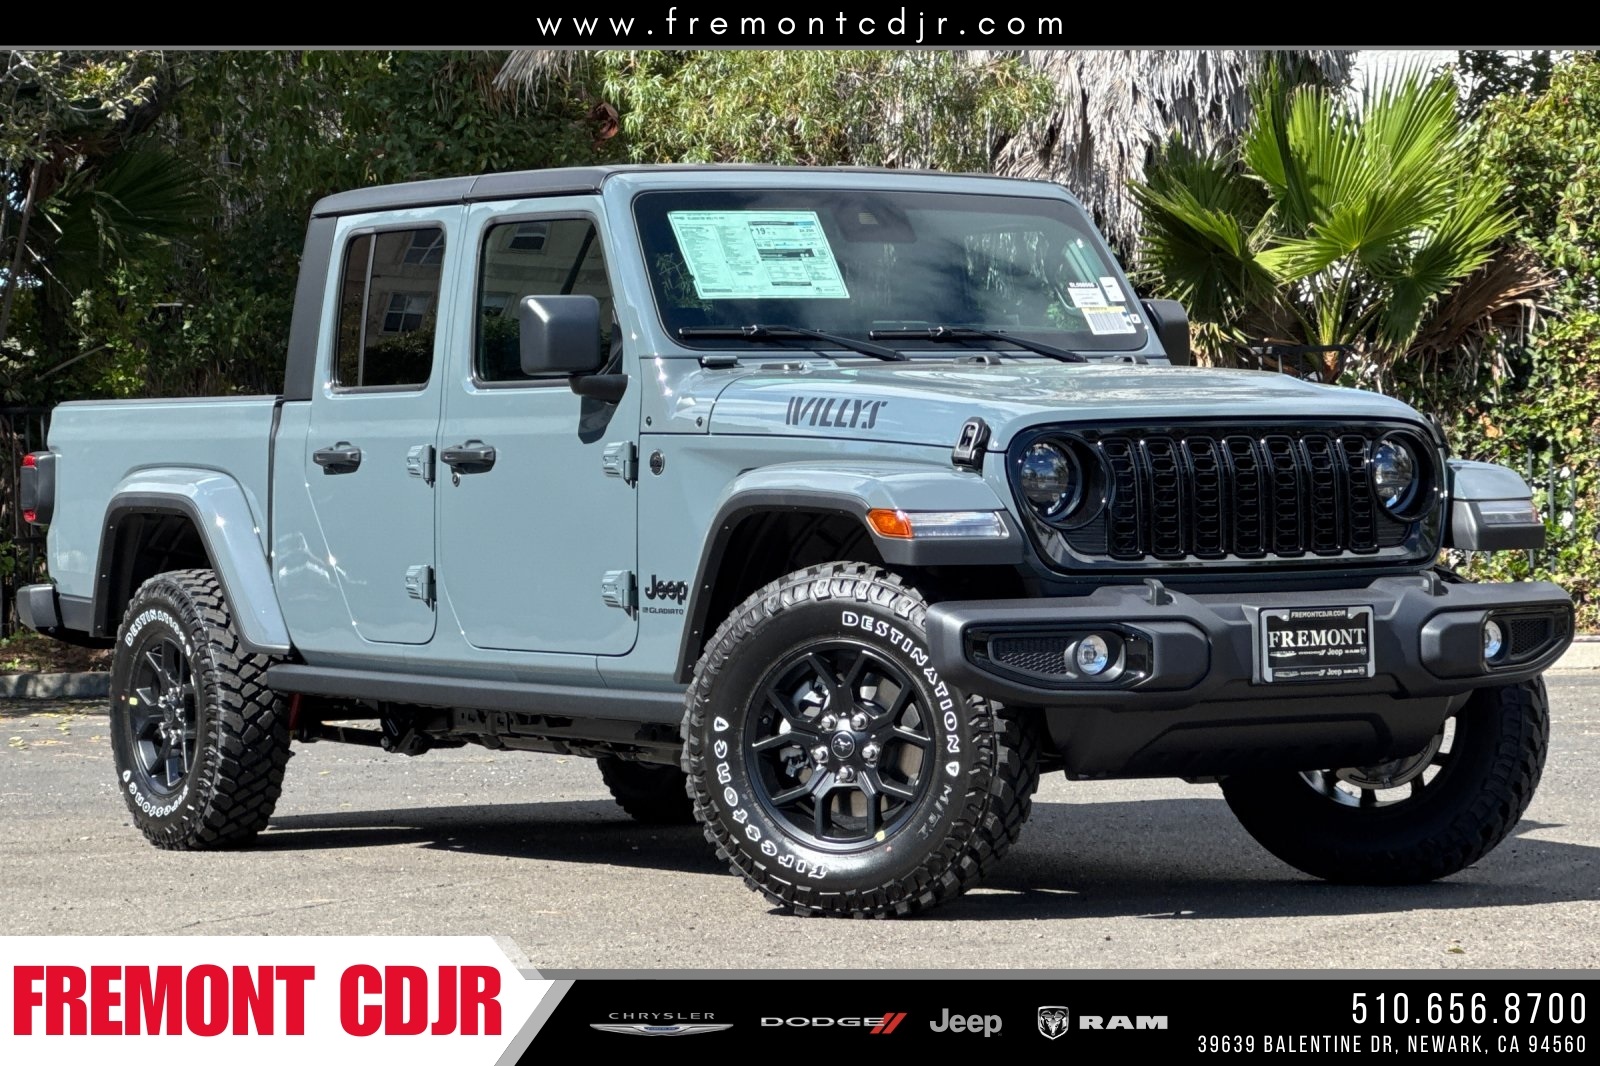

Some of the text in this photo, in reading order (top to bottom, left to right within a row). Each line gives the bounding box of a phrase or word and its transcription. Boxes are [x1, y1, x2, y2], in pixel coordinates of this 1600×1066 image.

[785, 396, 889, 429] WILLYS
[644, 574, 689, 606] Jeep
[1290, 609, 1347, 619] FREMONTCDJR.COM
[1267, 627, 1366, 649] FREMONT
[841, 610, 961, 754] DESTINATION
